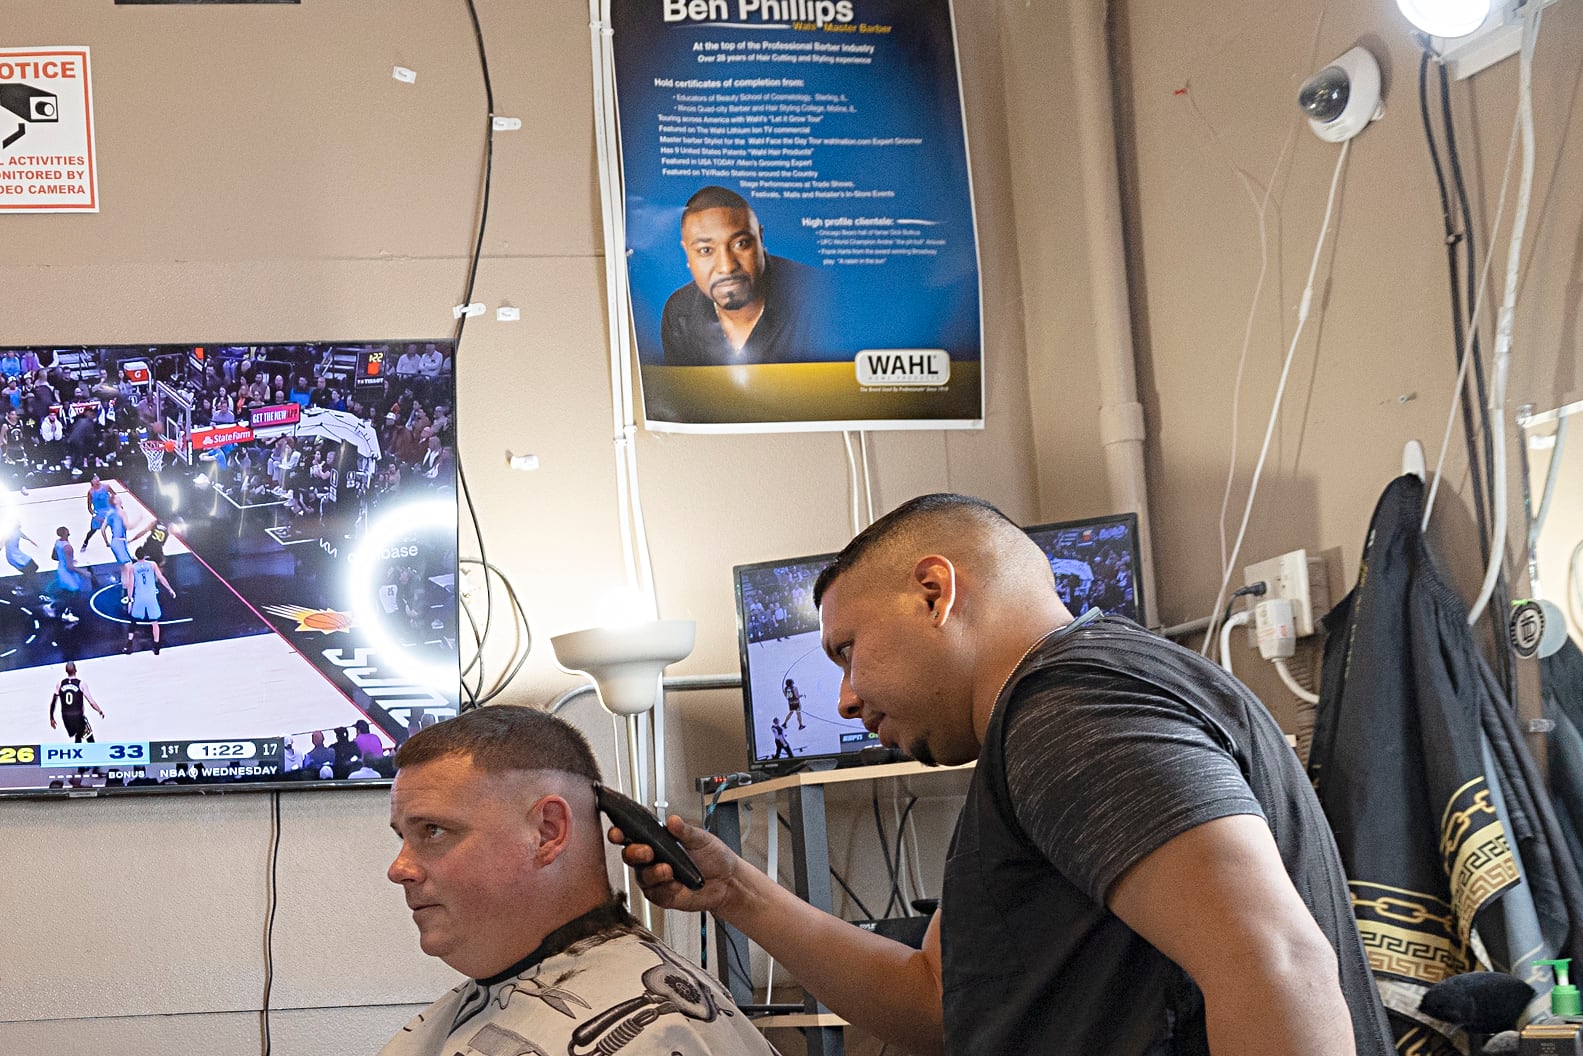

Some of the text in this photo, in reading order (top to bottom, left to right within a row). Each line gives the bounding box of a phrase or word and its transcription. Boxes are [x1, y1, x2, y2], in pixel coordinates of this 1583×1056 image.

[663, 0, 854, 27] Ben Phillips
[654, 77, 674, 88] Hold
[675, 78, 722, 89] certificates
[734, 78, 781, 90] completion
[8, 155, 85, 166] ACTIVITIES
[67, 170, 84, 180] BY
[28, 184, 86, 195] CAMERA
[867, 354, 939, 375] WAHL
[46, 741, 278, 763] PHX 33 1ST 1:22 17
[108, 764, 279, 780] BONUS NBA WEDNESDAY
